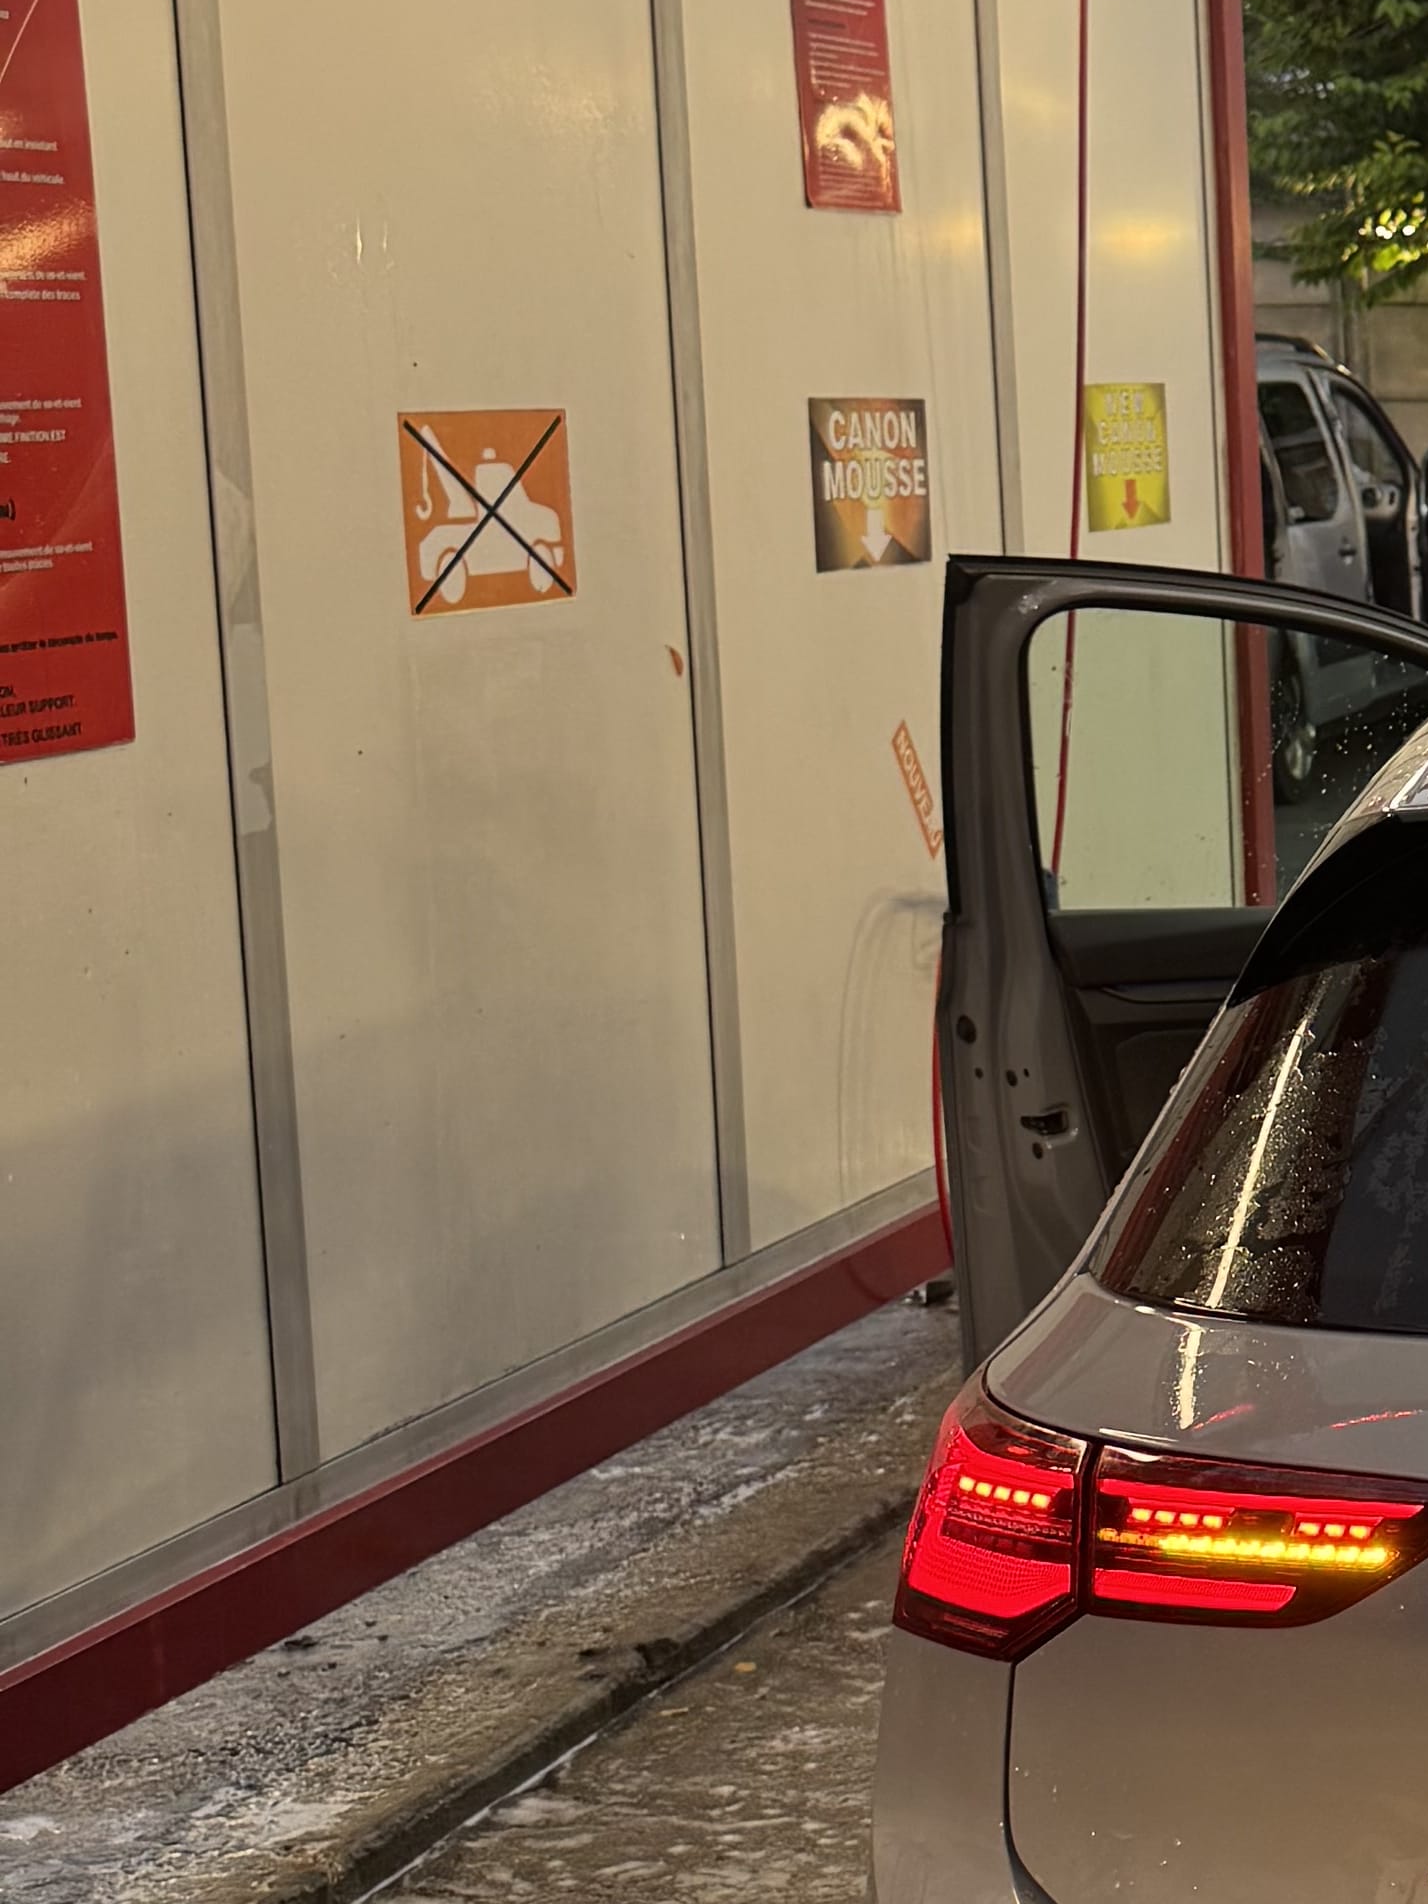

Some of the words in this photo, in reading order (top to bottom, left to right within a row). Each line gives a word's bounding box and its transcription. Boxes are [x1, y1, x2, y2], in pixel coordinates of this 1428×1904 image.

[1104, 390, 1145, 417] NEW
[828, 410, 918, 451] CANON
[1097, 420, 1157, 446] CANON
[1091, 447, 1164, 477] MOUSSE
[822, 458, 928, 502] MOUSSE
